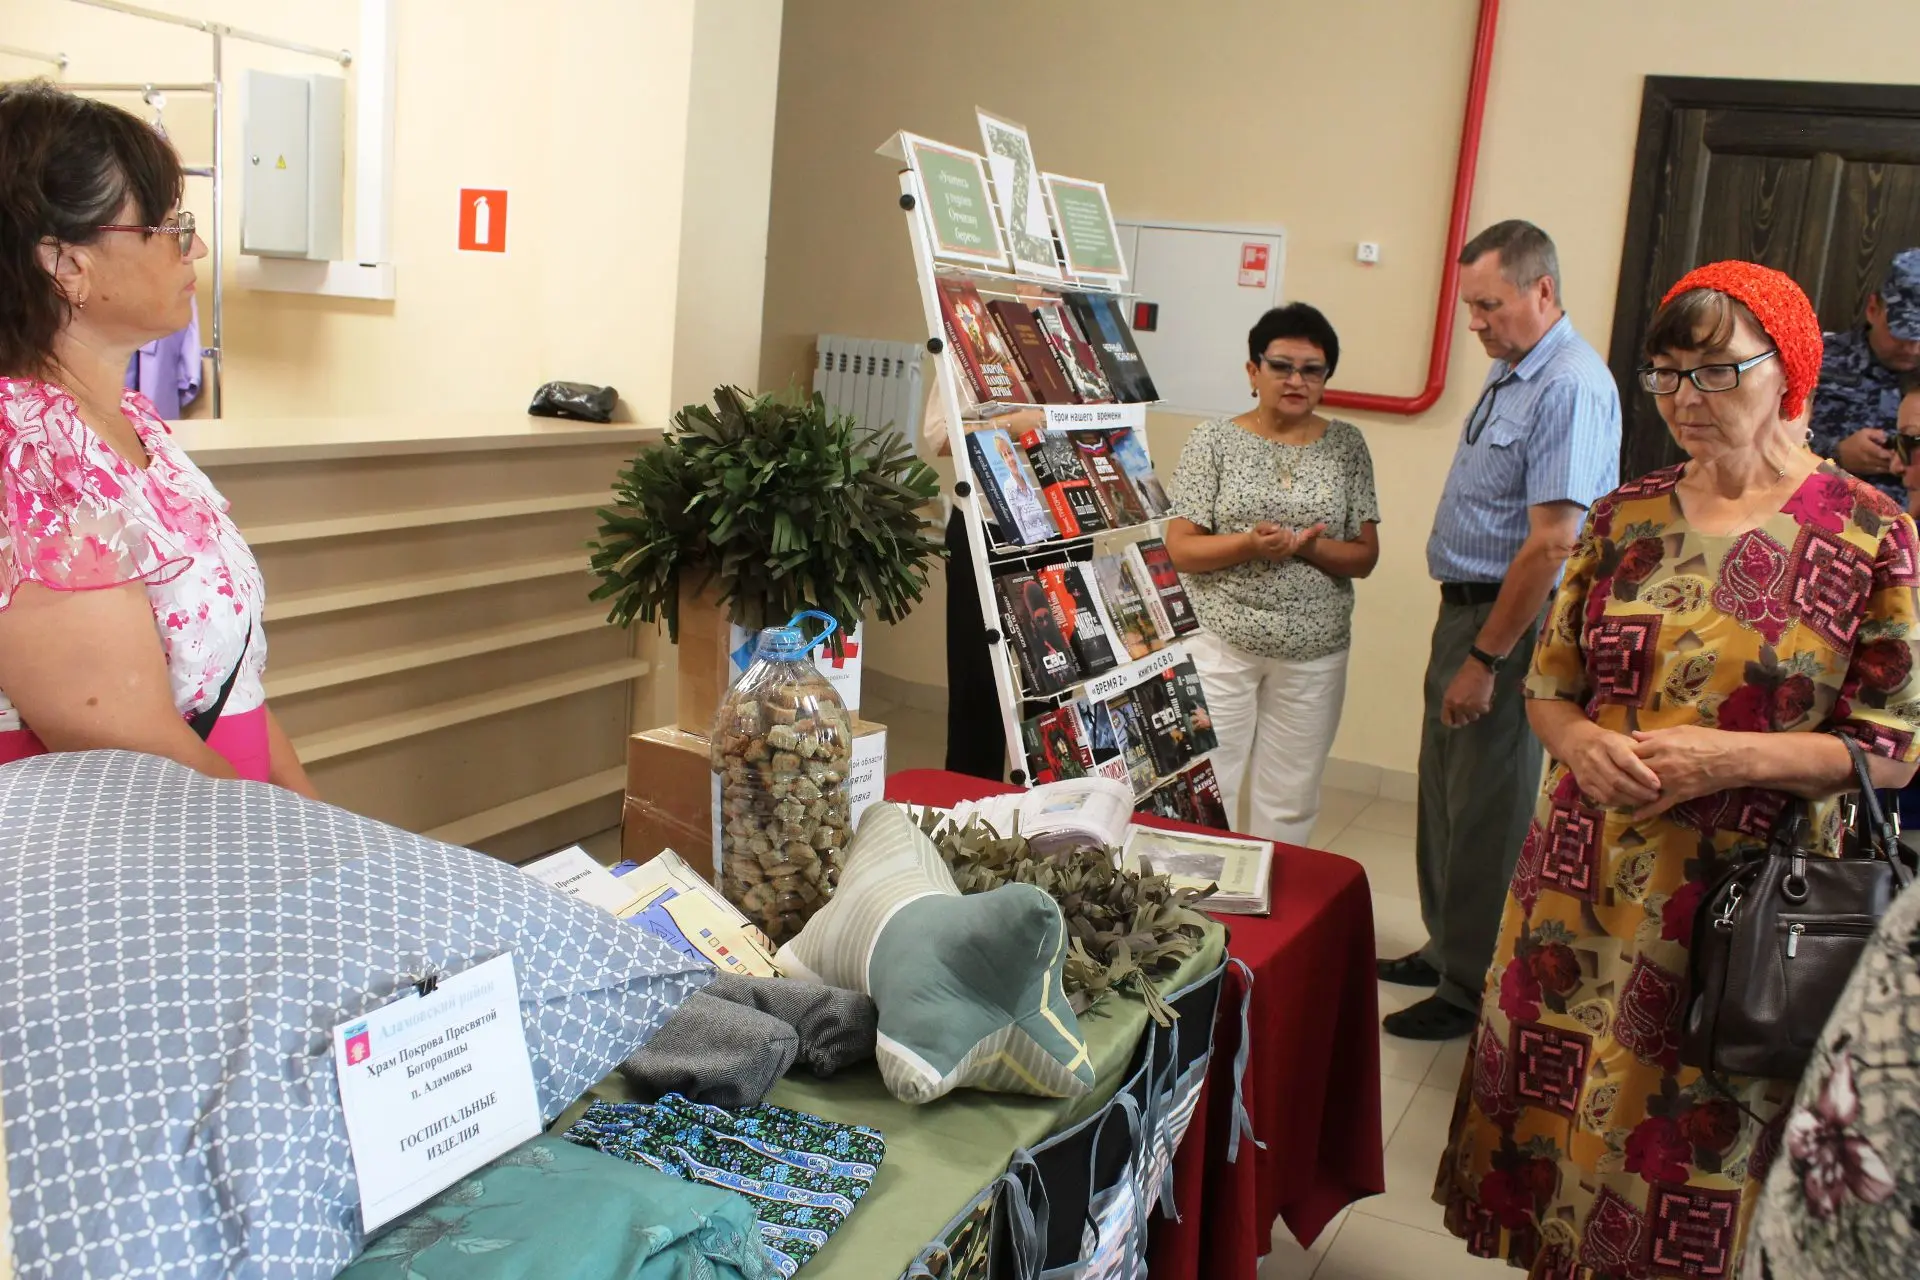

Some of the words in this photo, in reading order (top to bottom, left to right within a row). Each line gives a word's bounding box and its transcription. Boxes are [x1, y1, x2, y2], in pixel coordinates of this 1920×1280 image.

[1050, 410, 1069, 421] Герои
[1070, 412, 1093, 422] нашего
[1097, 412, 1121, 423] времени
[1091, 678, 1118, 695] «ВРЕМЯ
[366, 1057, 397, 1078] Храм
[398, 1035, 444, 1063] Покрова
[445, 1008, 497, 1042] Пресвятой
[406, 1042, 468, 1078] Богородицы
[411, 1089, 422, 1101] п.
[423, 1063, 473, 1094] Адамовка
[399, 1091, 498, 1152] ГОСПИТАЛЬНЫЕ
[426, 1122, 480, 1161] ИЗДЕЛИЯ
